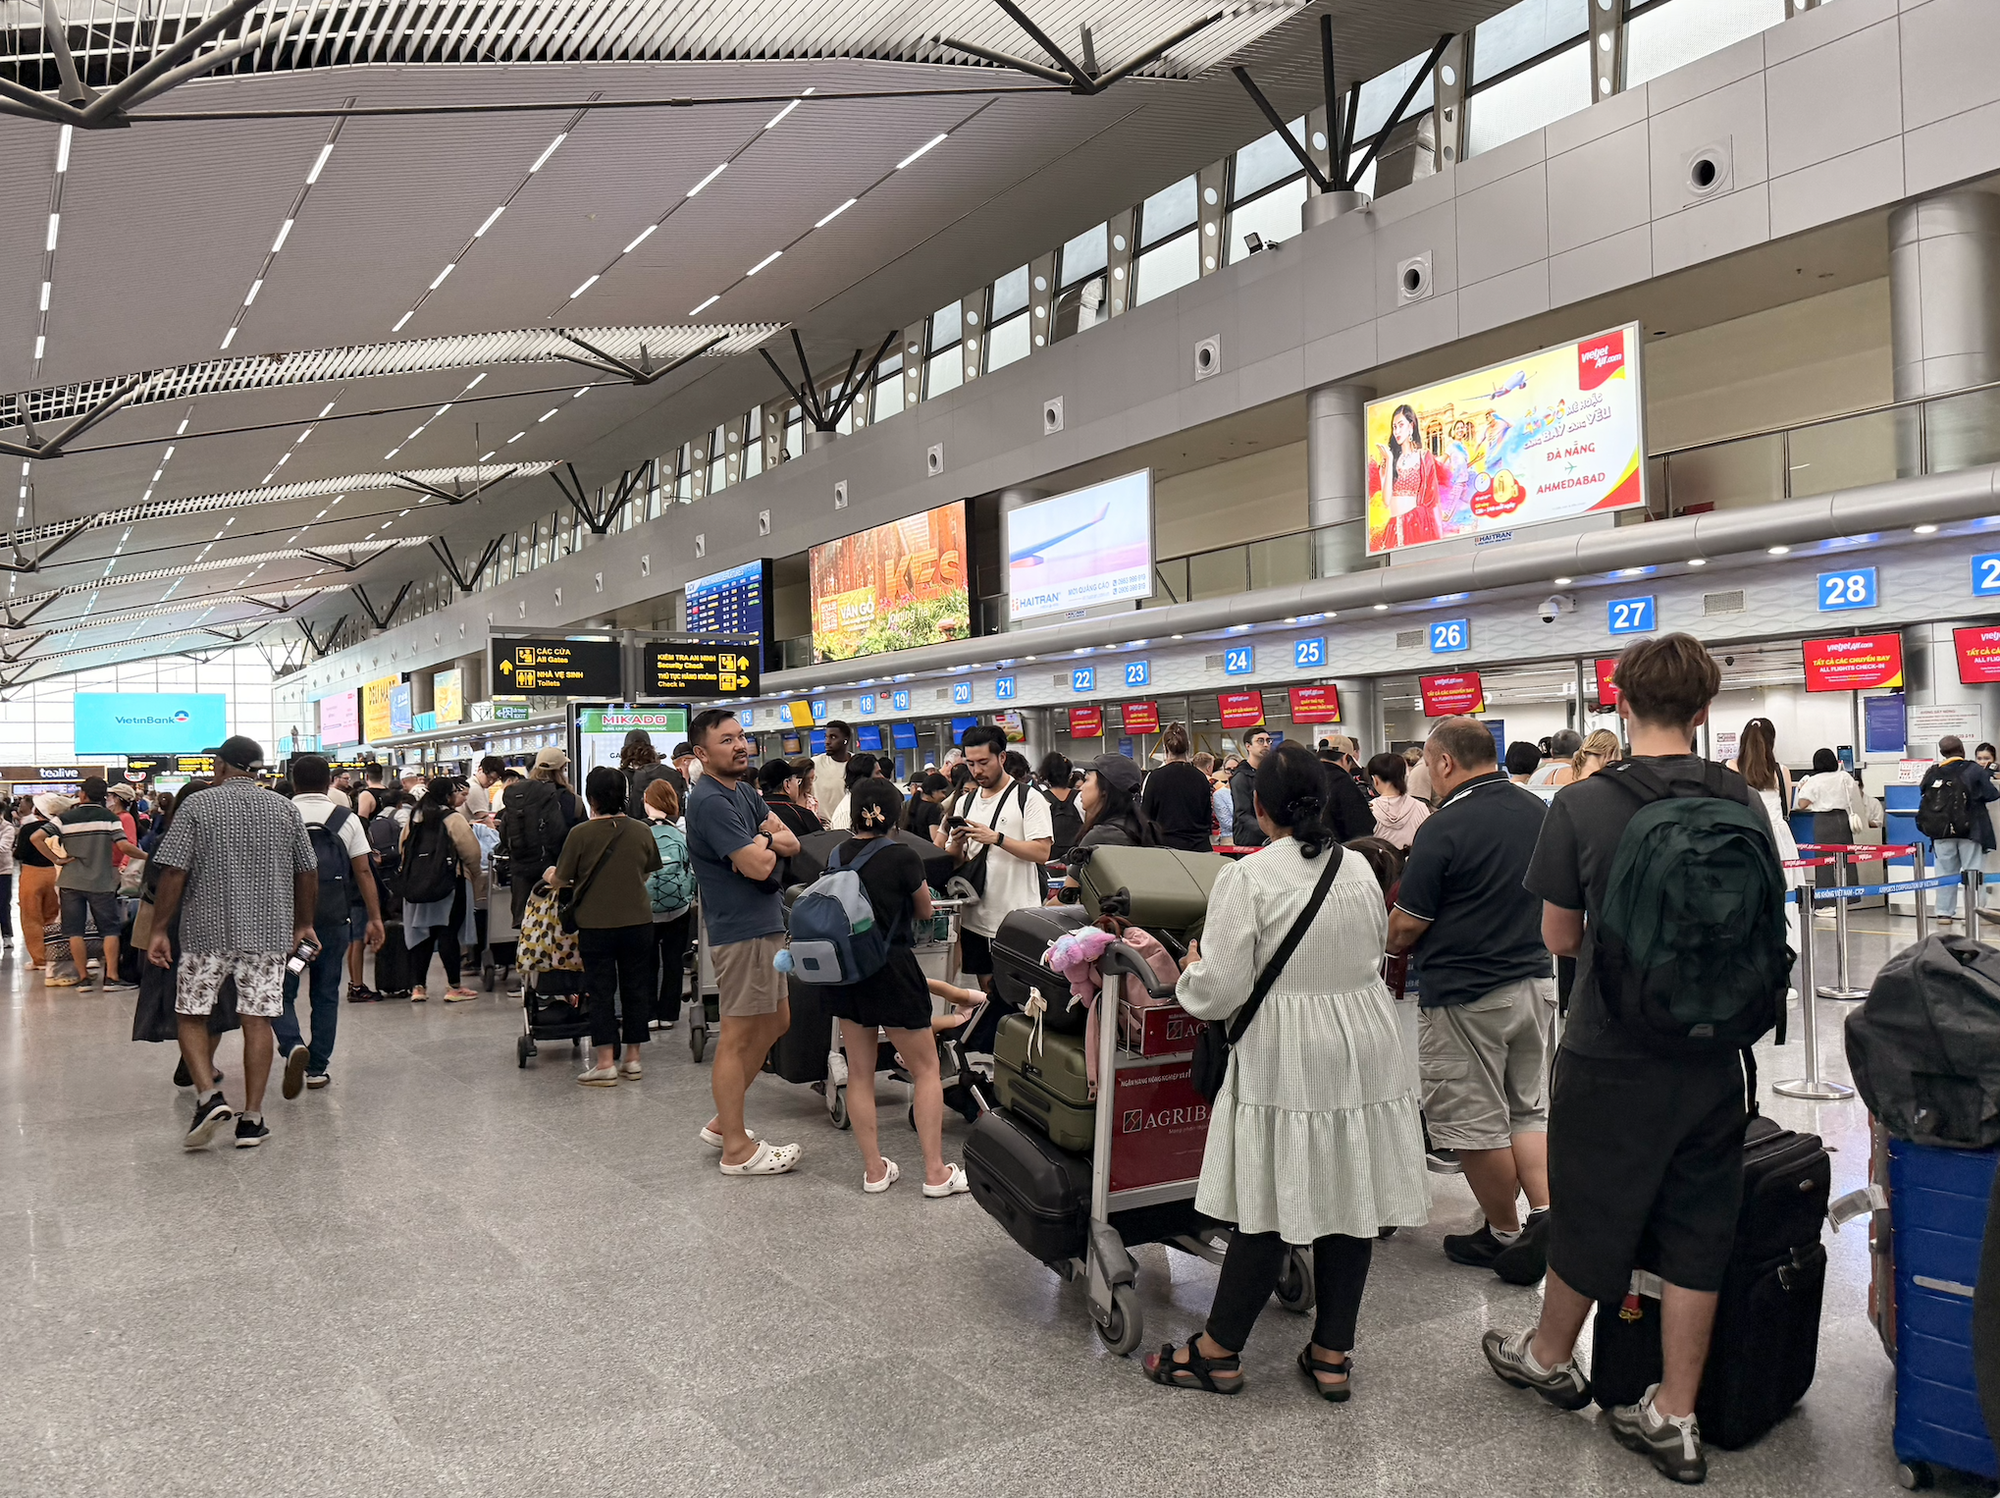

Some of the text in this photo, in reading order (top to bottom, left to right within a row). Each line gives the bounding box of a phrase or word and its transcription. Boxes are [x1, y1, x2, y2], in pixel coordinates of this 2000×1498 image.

[1536, 472, 1606, 495] AHMEDABAD
[1980, 558, 2000, 588] 2
[1825, 575, 1866, 605] 28
[1020, 592, 1060, 608] HAITRAN
[1613, 602, 1646, 628] 27
[1434, 624, 1461, 647] 26
[536, 647, 571, 656] CÁC CỬA
[700, 654, 717, 662] NINH
[1298, 642, 1320, 663] 25
[547, 656, 569, 664] Gates
[657, 662, 684, 670] Security
[1228, 651, 1247, 670] 24
[1835, 656, 1848, 664] CÁC
[1855, 663, 1885, 671] CHECK-IN
[536, 670, 554, 678] NHÀ
[554, 671, 565, 679] VỆ
[1075, 671, 1091, 688] 22
[1128, 665, 1144, 683] 23
[955, 685, 968, 700] 20
[998, 680, 1011, 696] 21
[861, 697, 872, 711] 18
[895, 693, 906, 707] 19
[781, 707, 791, 719] 16
[813, 703, 823, 716] 17
[115, 716, 175, 724] VietinBank
[602, 714, 667, 725] MIKADO
[742, 712, 751, 724] 15
[39, 768, 78, 778] tealive
[1144, 1105, 1212, 1129] AGRIB
